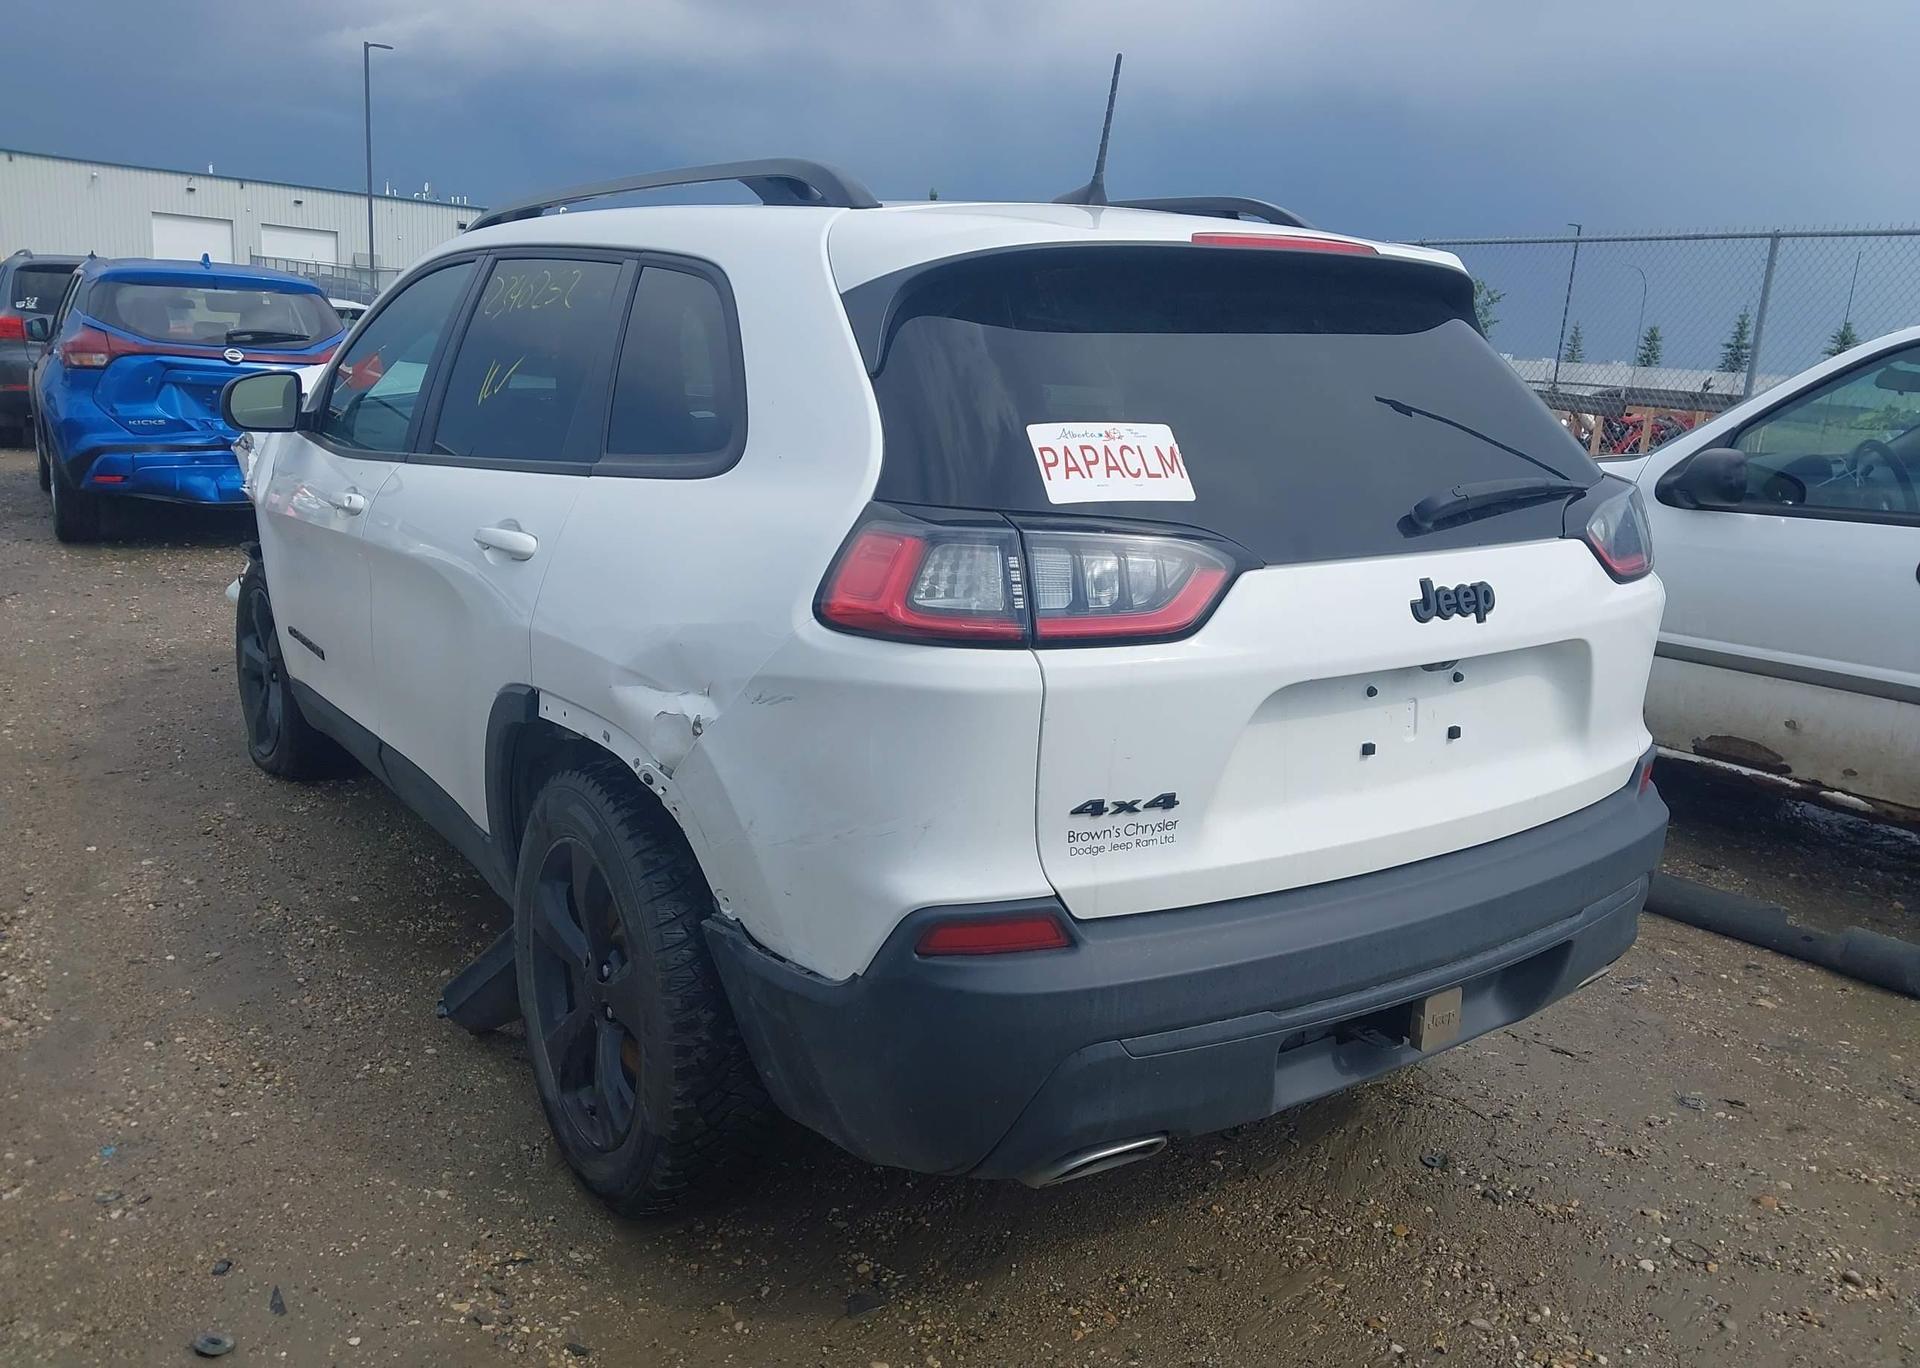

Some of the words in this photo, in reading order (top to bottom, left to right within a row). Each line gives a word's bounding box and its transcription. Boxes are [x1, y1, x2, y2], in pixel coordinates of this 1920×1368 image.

[1056, 427, 1097, 440] Alberta
[1037, 444, 1185, 481] PAPACLM
[1410, 577, 1496, 624] Jeep
[1069, 792, 1180, 817] 4x4
[1067, 825, 1121, 844] Brown's
[1123, 818, 1180, 837] Chrysler
[1069, 844, 1106, 857] Dodge
[1108, 841, 1134, 852] Jeep
[1135, 837, 1158, 848] Ram
[1159, 833, 1177, 845] Ltd.
